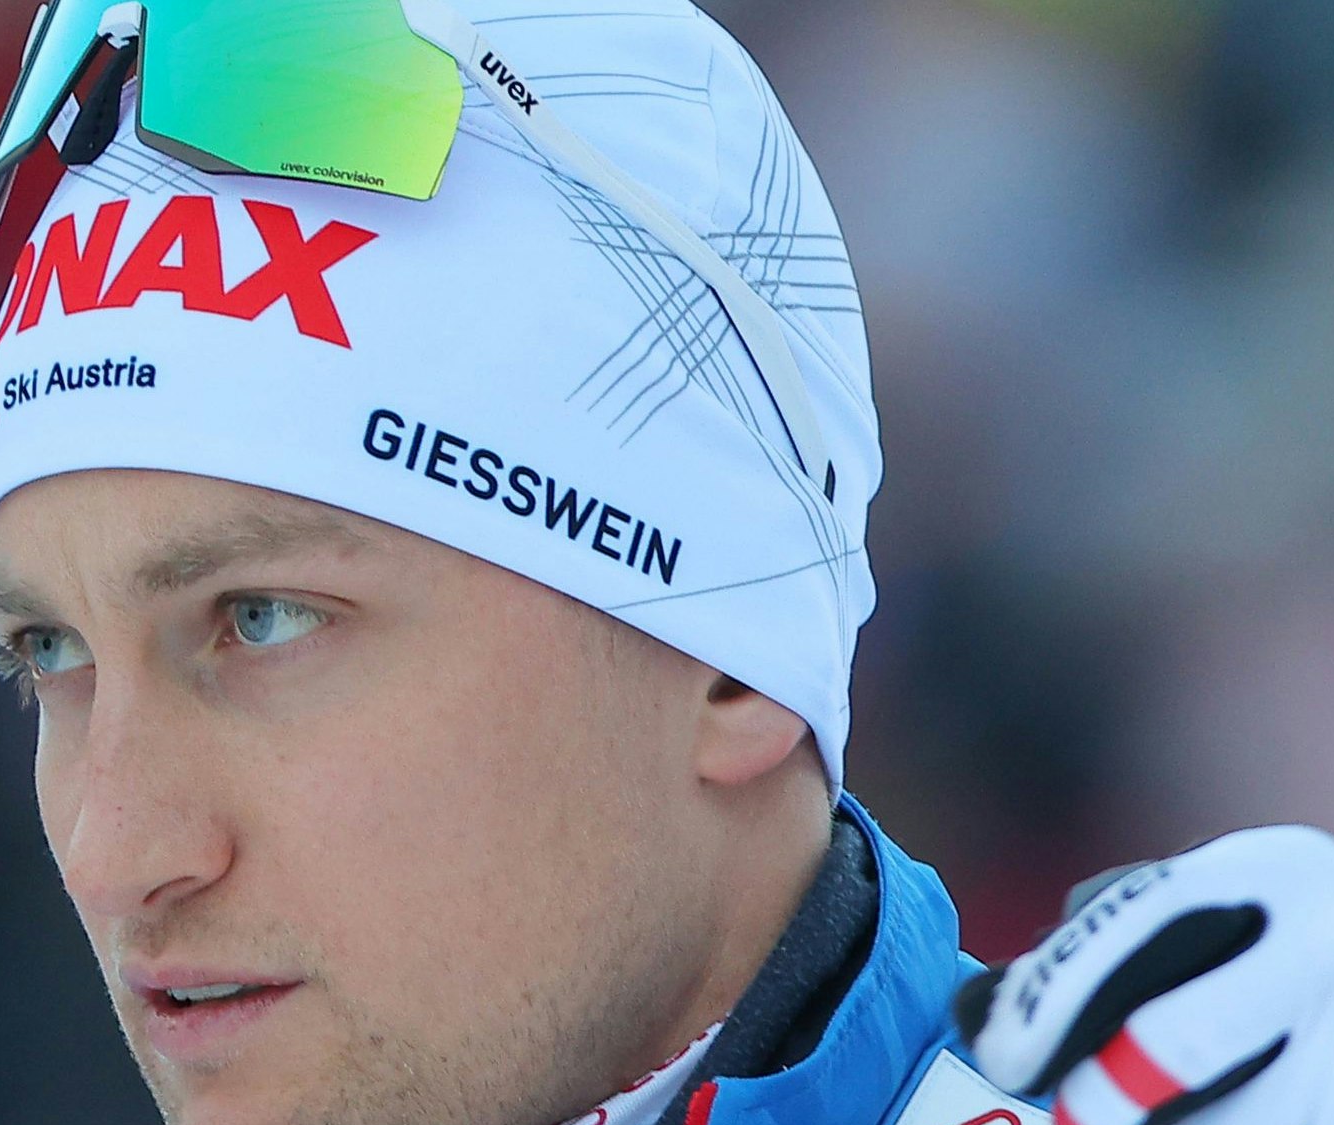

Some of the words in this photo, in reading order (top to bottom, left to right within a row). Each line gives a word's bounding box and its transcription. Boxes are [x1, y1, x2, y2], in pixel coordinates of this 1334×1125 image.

[479, 50, 540, 117] uvex
[280, 162, 311, 174] uvex
[313, 166, 385, 187] colorvision
[3, 369, 38, 410] Ski
[45, 355, 156, 395] Austria
[362, 408, 682, 586] GIESSWEIN
